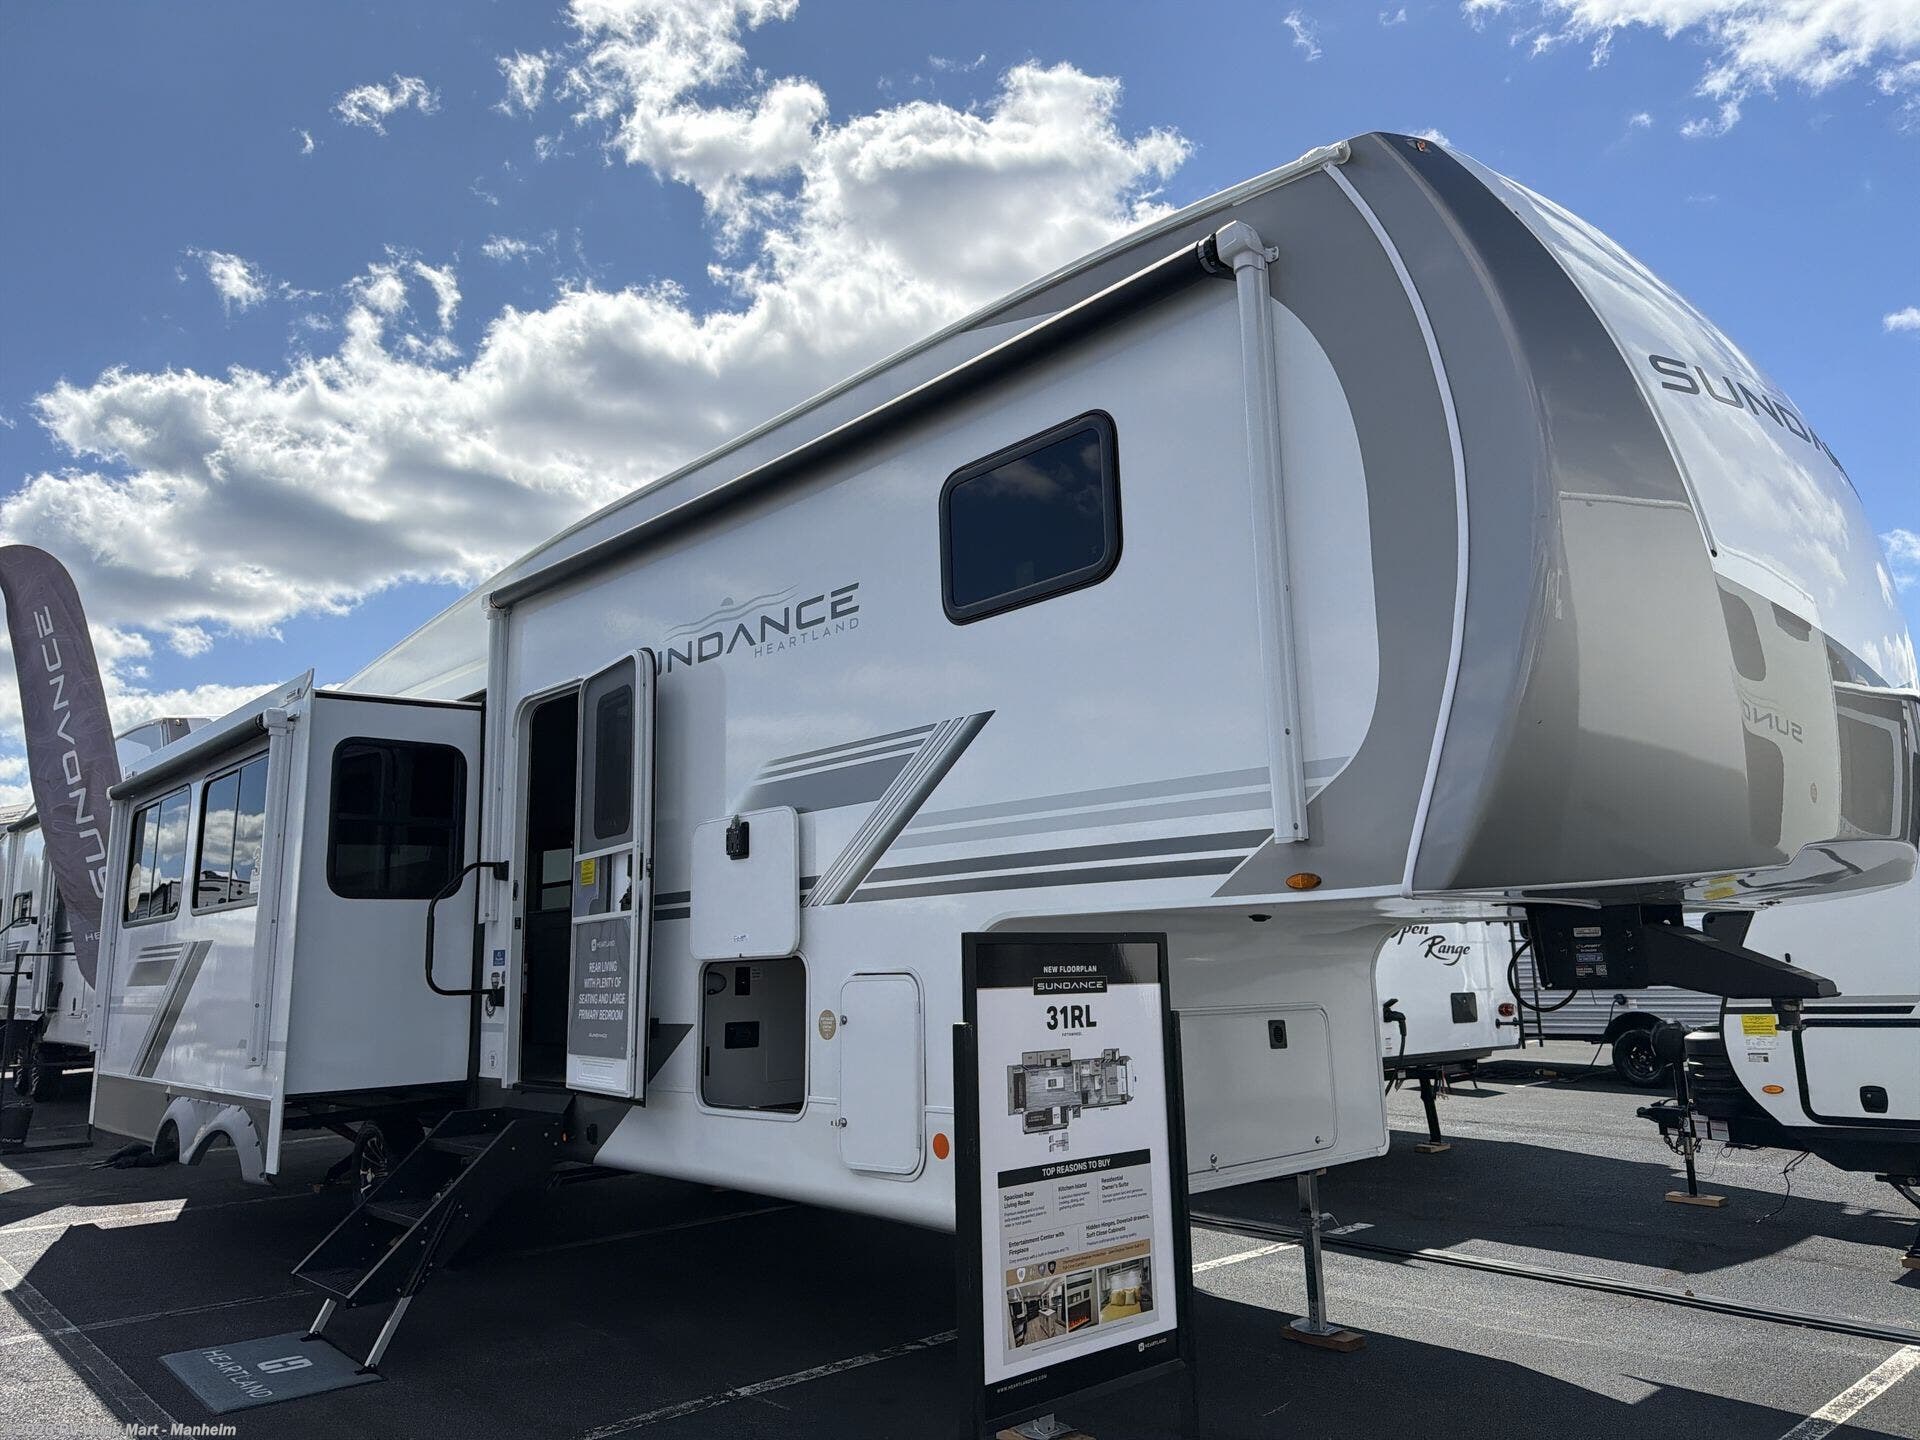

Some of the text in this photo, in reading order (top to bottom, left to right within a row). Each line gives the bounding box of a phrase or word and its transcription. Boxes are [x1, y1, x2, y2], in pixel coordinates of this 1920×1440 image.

[657, 581, 860, 676] NDANCE
[754, 617, 860, 659] HEARTLAND
[1391, 925, 1430, 946] pen
[1418, 935, 1471, 967] Range
[589, 961, 618, 973] REAR LIVING
[1043, 965, 1097, 974] NEW FLOORPLAN
[597, 977, 614, 988] PLENTY
[614, 977, 622, 988] OF
[1037, 981, 1104, 991] SUNDANCE
[609, 993, 626, 1004] LARGE
[599, 1009, 624, 1021] BEDROOM
[1046, 1004, 1097, 1031] 31RL
[1042, 1158, 1111, 1177] TOP REASONS TO BUY
[202, 1350, 273, 1398] HEARTLAND
